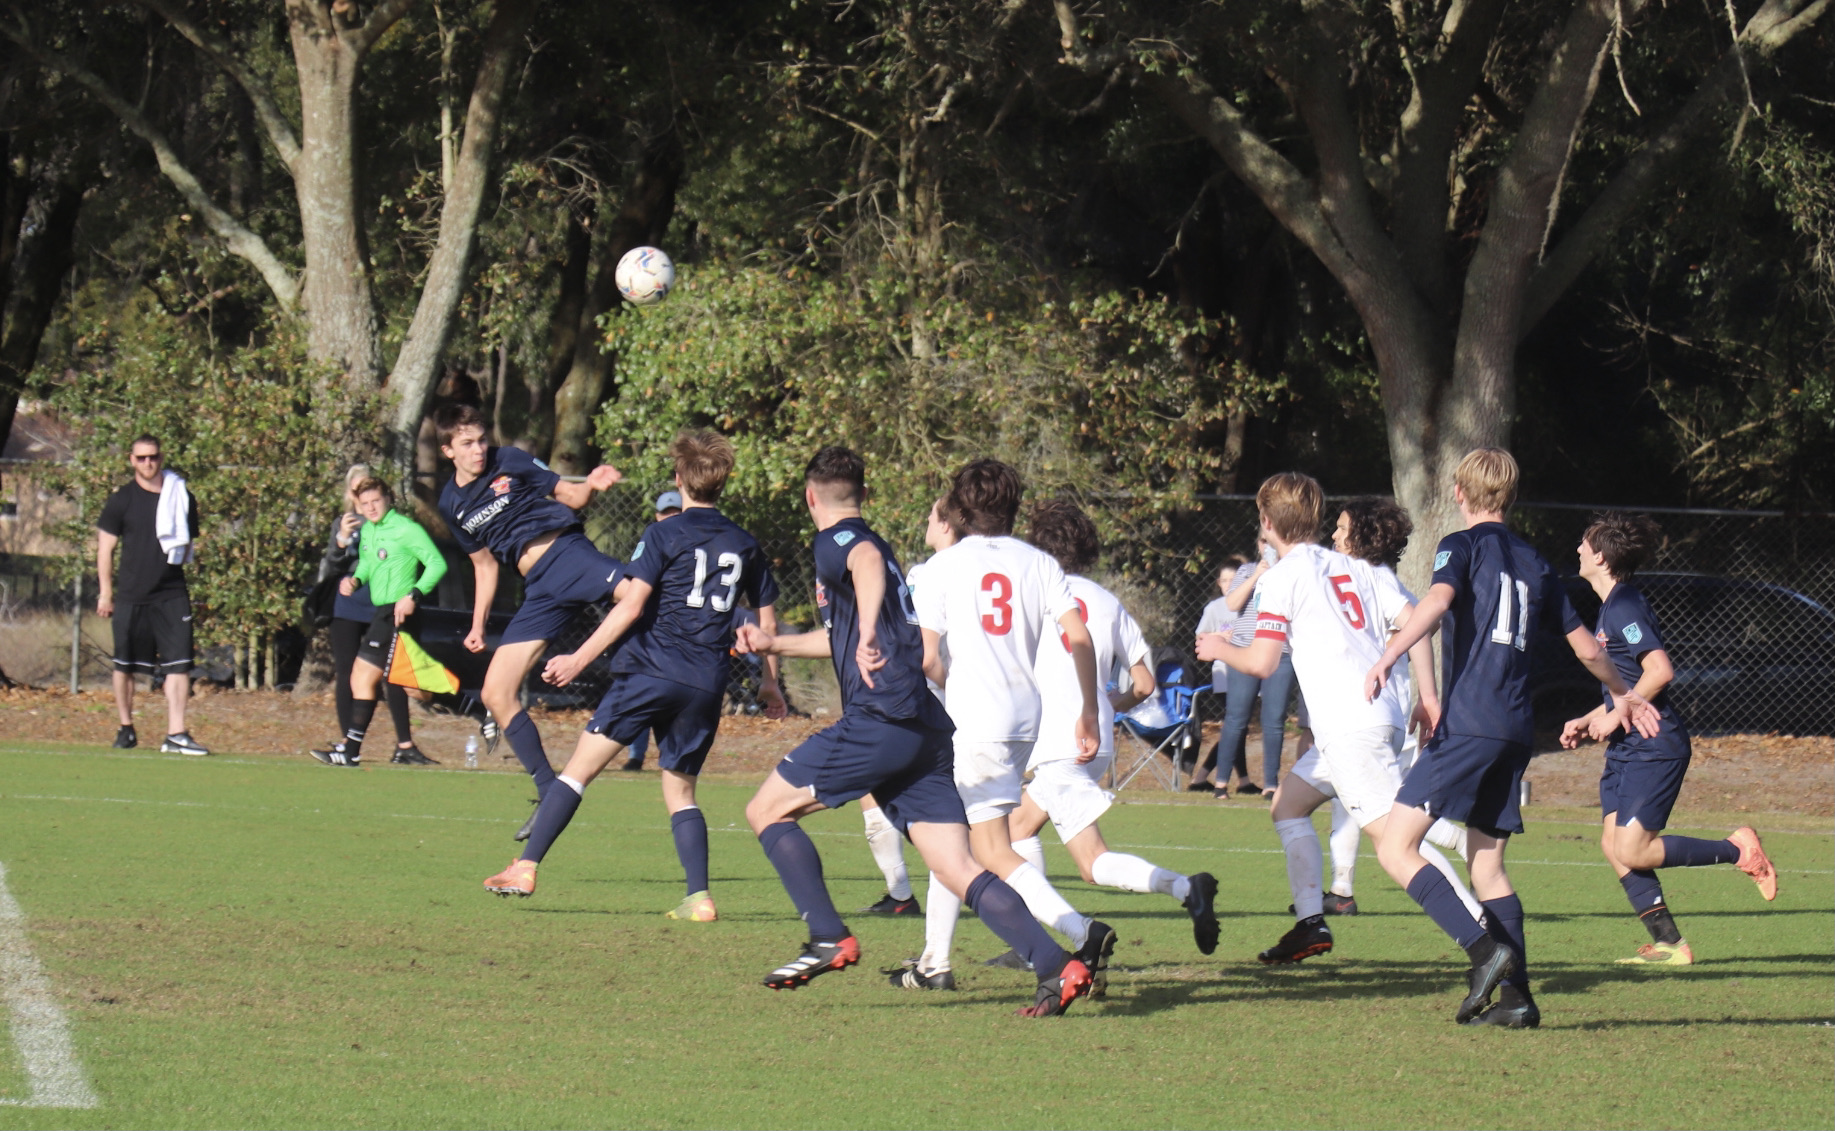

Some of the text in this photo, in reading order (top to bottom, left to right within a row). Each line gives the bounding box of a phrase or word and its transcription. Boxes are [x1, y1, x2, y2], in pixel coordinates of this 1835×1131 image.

[686, 548, 742, 613] 13
[981, 572, 1012, 636] 3
[1326, 574, 1366, 630] 5
[1491, 571, 1528, 652] 11
